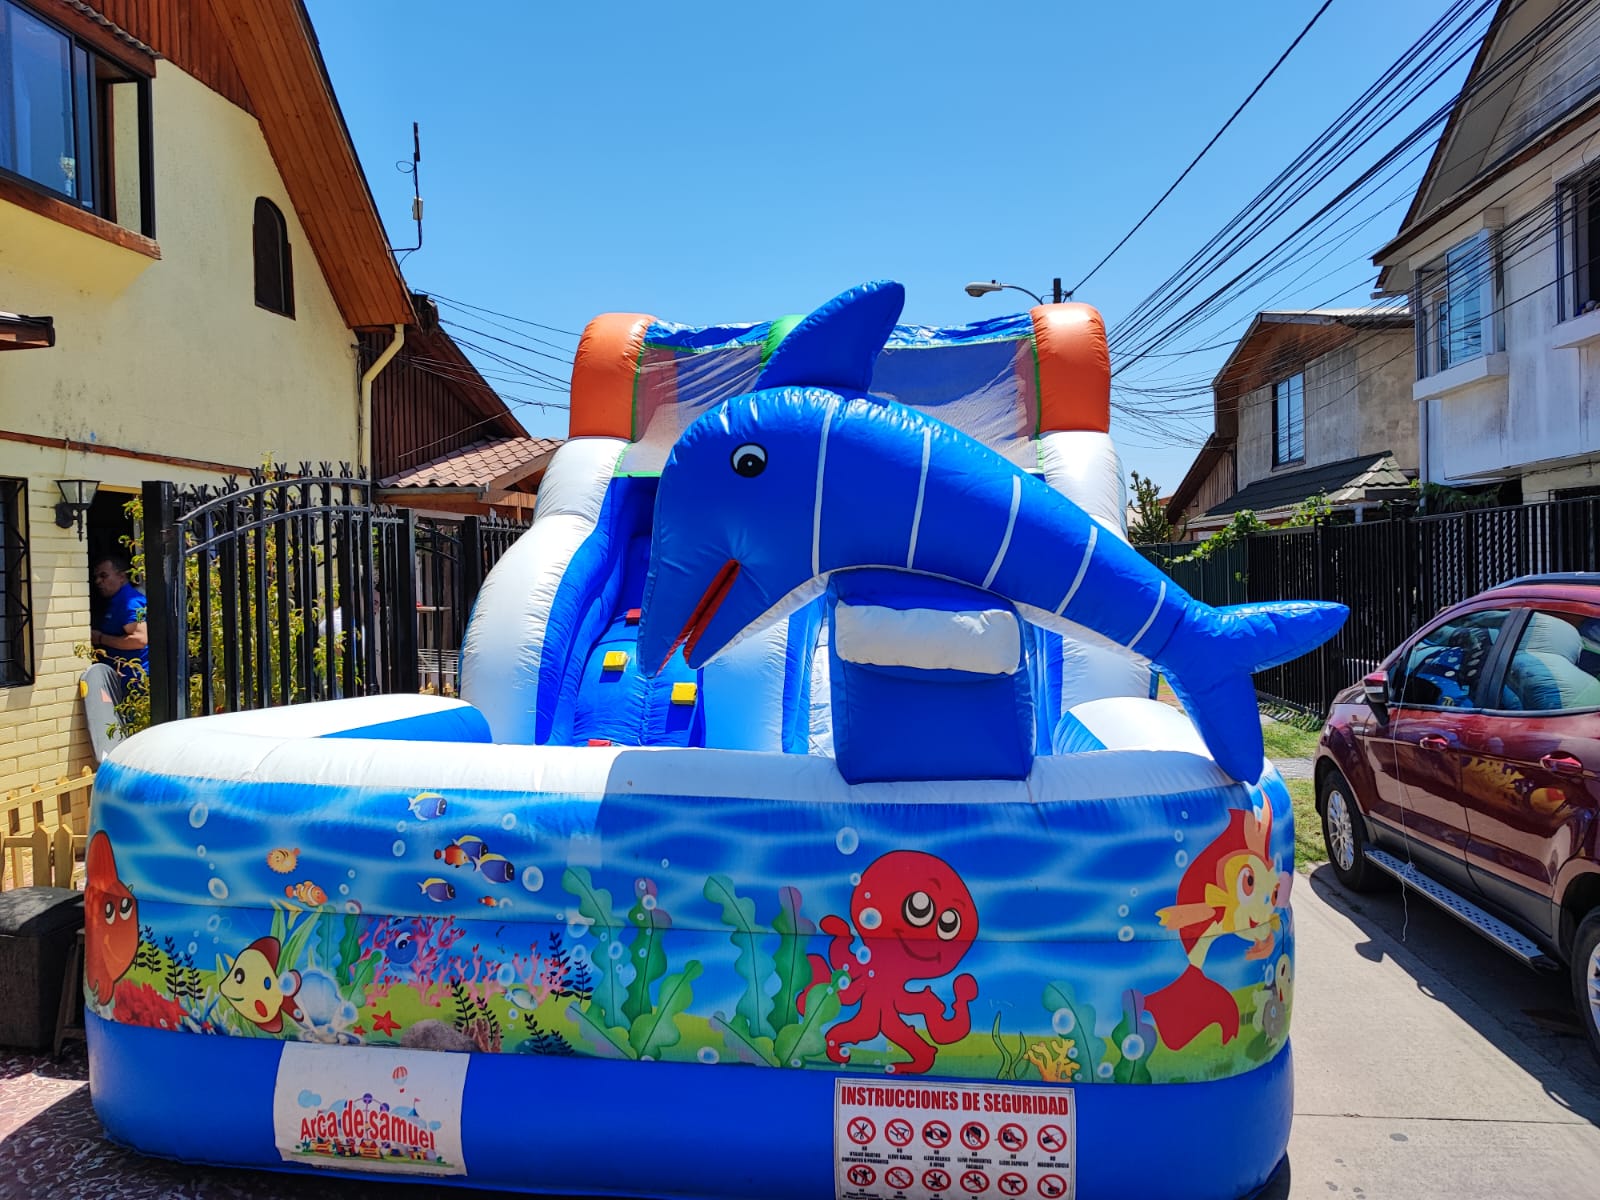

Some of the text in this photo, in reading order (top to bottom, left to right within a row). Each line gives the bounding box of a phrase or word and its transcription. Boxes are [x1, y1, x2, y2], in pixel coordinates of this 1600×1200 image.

[841, 1085, 1069, 1116] INSTRUCCIONES DE SEGURIDAD
[301, 1100, 434, 1149] Arca de samuel
